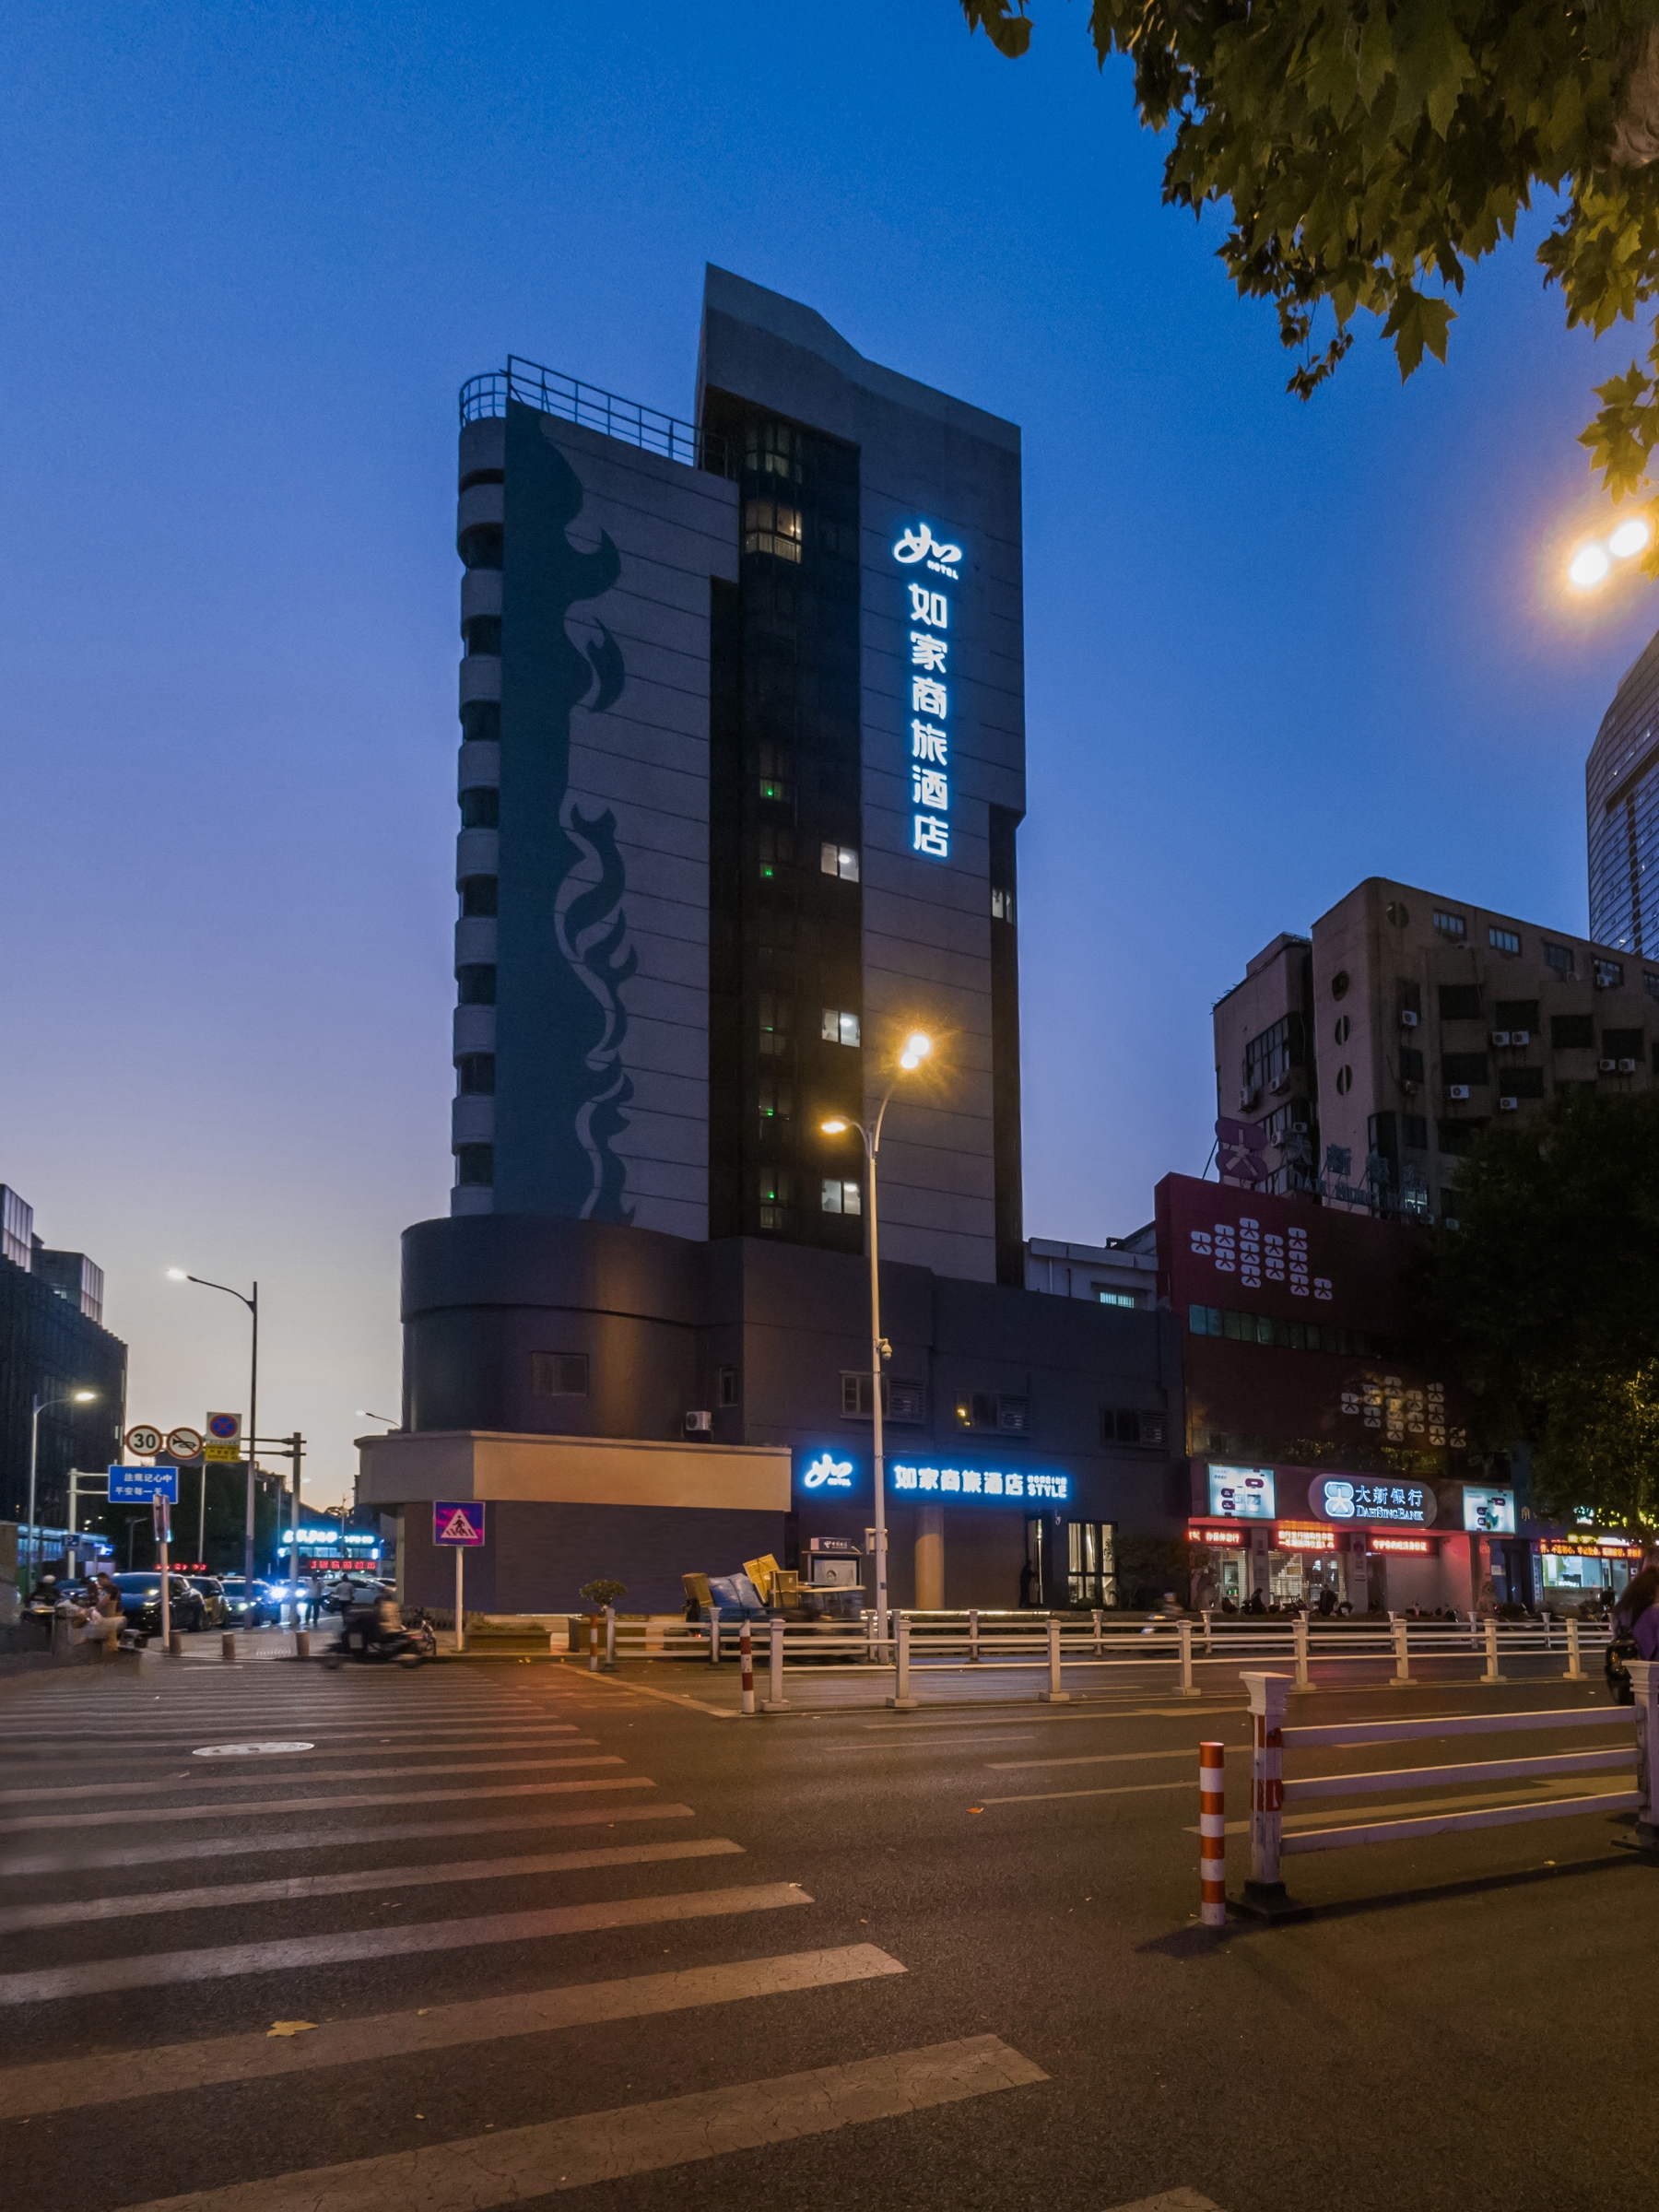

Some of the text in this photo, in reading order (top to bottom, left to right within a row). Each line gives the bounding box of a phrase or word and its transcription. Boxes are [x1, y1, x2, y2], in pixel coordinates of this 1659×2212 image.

[926, 559, 959, 580] HOTEL
[908, 582, 949, 858] 如家商旅酒店
[134, 1433, 156, 1449] 30
[894, 1465, 1023, 1496] 如家商旅酒店
[1028, 1483, 1067, 1498] STYLE
[114, 1487, 162, 1496] 平安每一天
[1355, 1485, 1423, 1507] 大新银行
